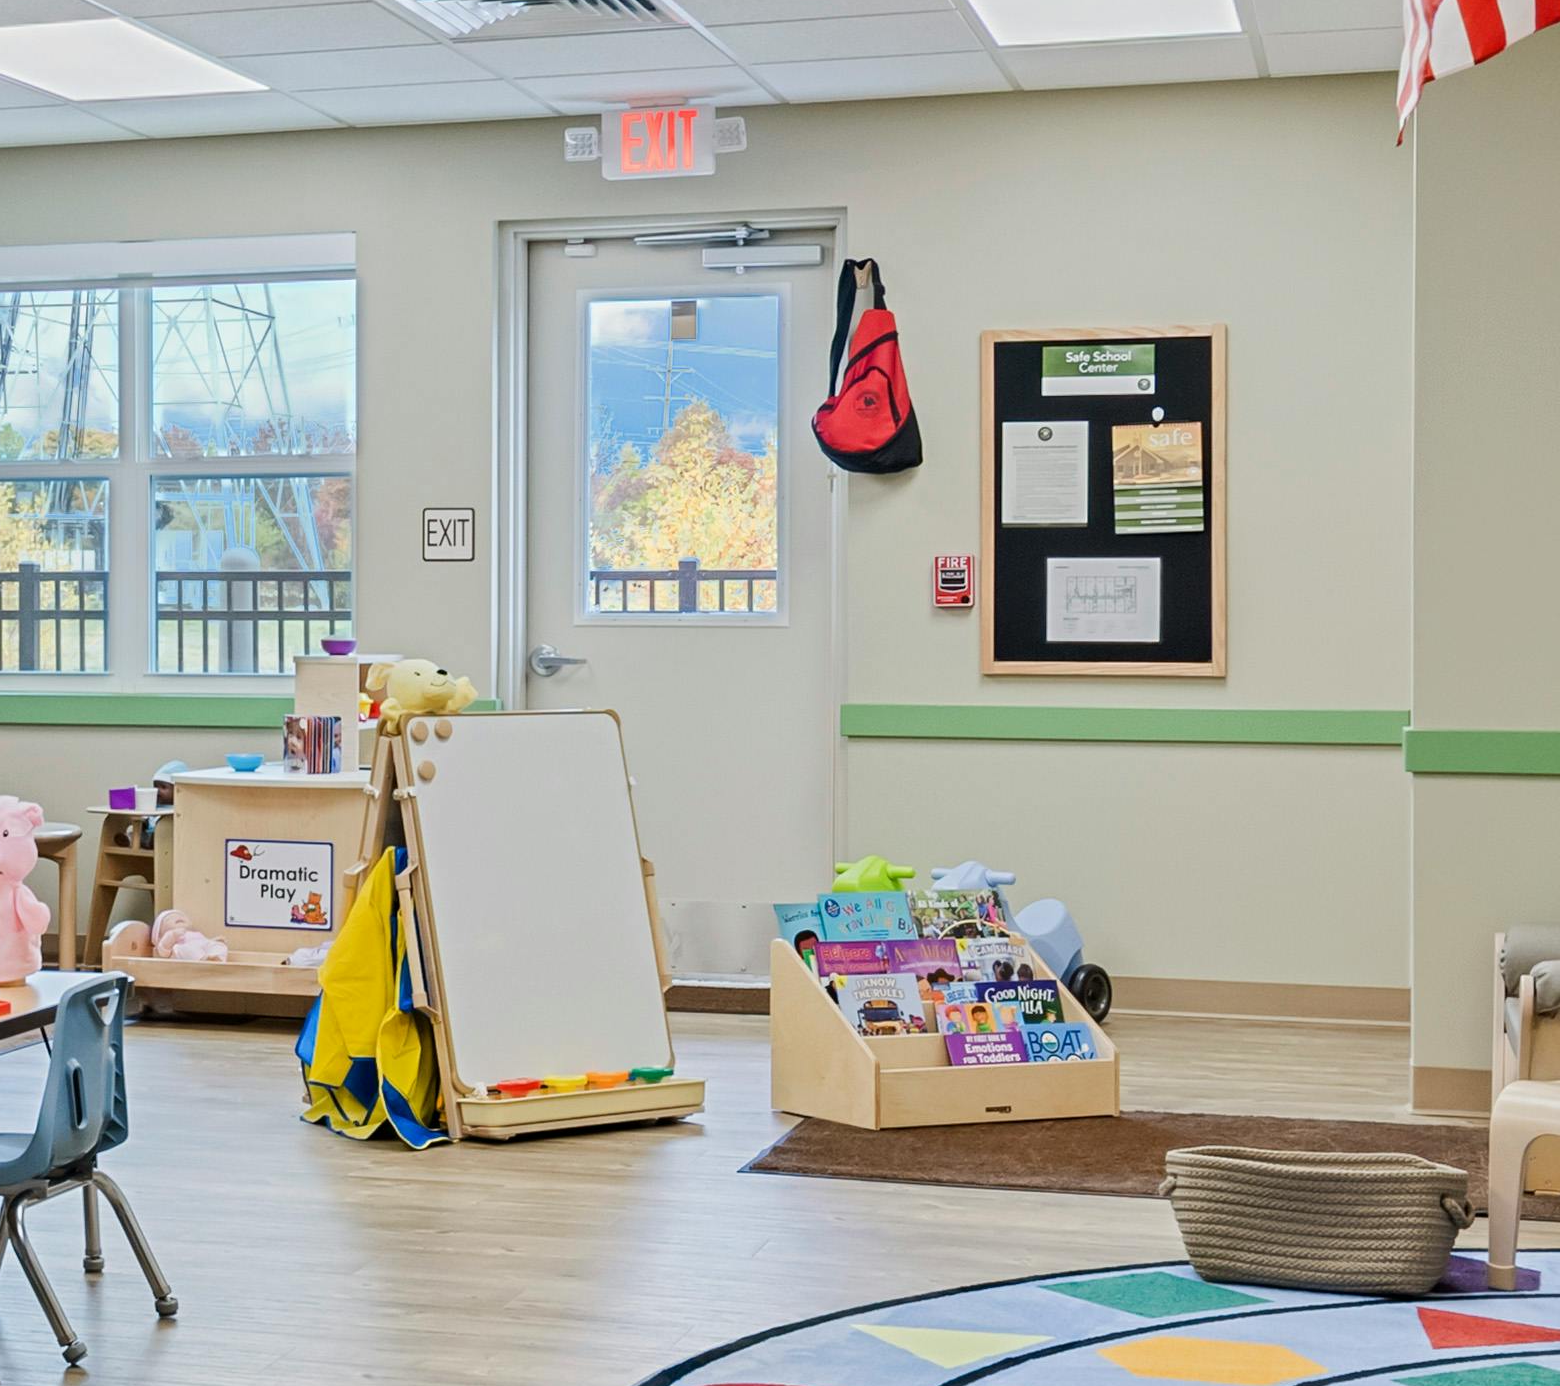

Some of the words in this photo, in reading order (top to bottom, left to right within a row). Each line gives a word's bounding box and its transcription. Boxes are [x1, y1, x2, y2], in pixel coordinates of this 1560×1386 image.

[620, 109, 698, 174] EXIT
[1065, 351, 1090, 363] Safe
[1092, 350, 1132, 362] School
[1078, 362, 1118, 373] Center
[1149, 428, 1193, 447] safe
[427, 519, 470, 547] EXIT
[938, 557, 968, 568] FIRE
[240, 865, 319, 882] Dramatic
[260, 884, 296, 903] Play
[976, 944, 994, 956] CAN
[994, 944, 1025, 957] SHARE
[864, 978, 896, 987] KNOW
[854, 989, 871, 999] THE
[875, 988, 904, 999] RULES
[984, 987, 1016, 1003] GOOD
[964, 1042, 1013, 1054] Emotions
[1028, 1030, 1081, 1054] BOAT
[978, 1052, 1022, 1064] Toddlers
